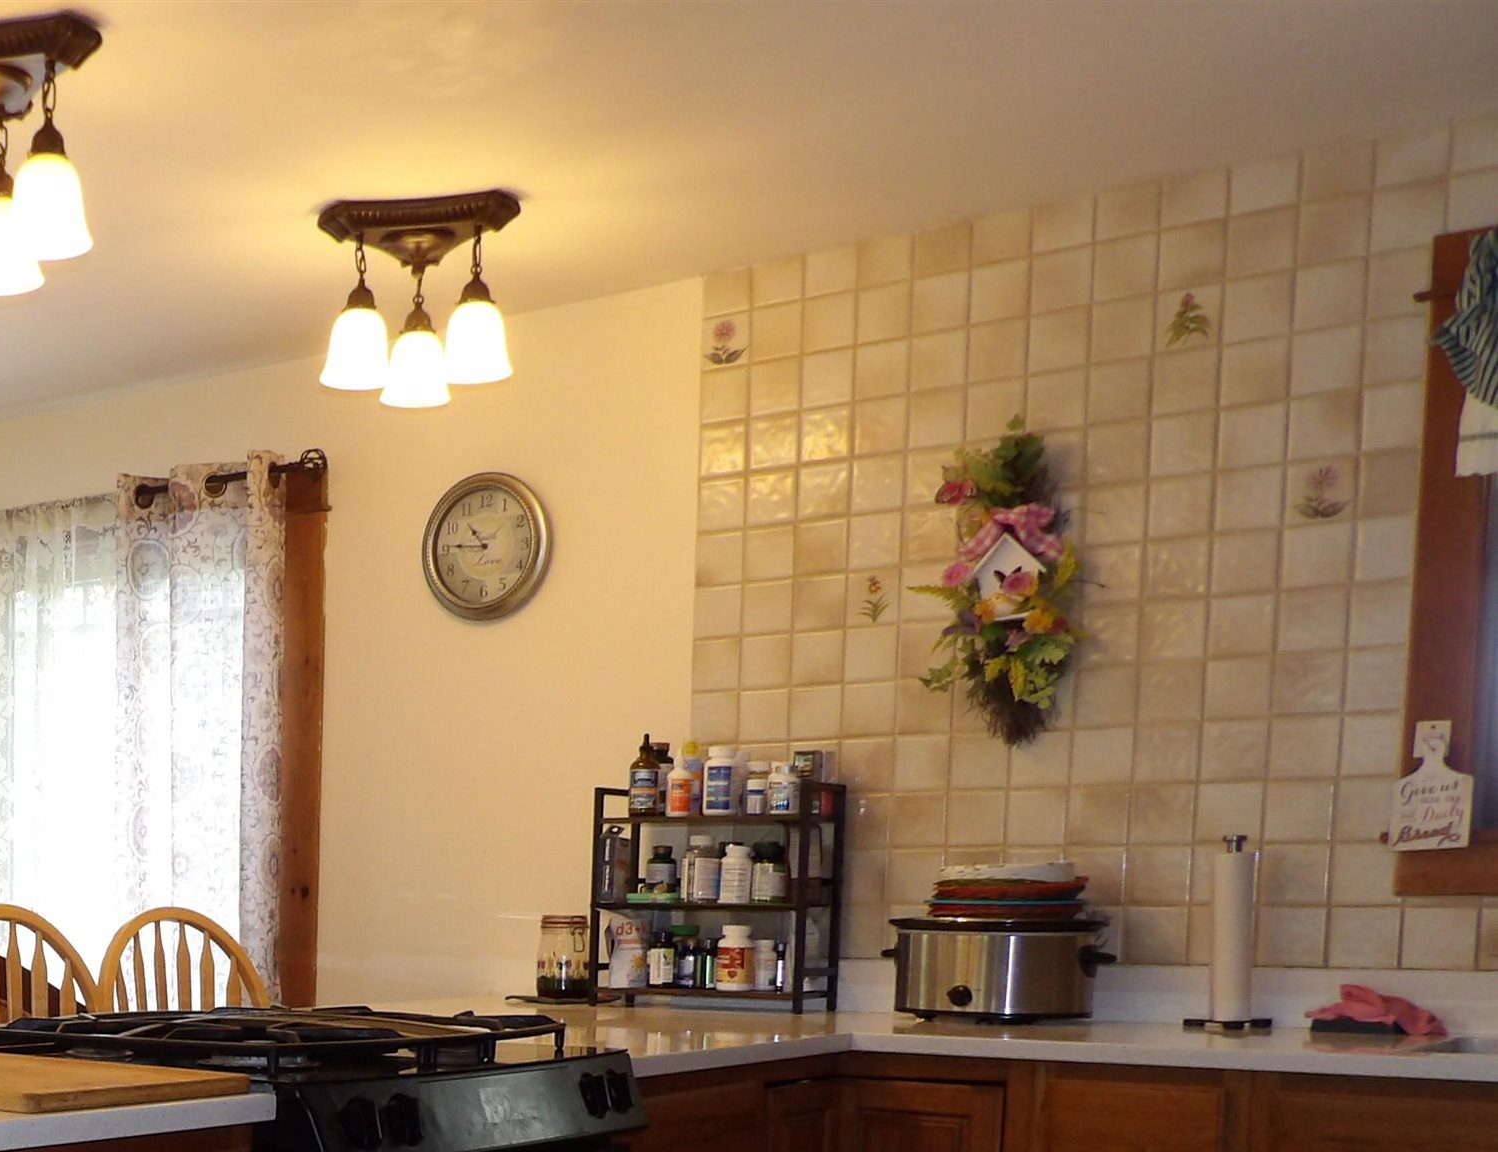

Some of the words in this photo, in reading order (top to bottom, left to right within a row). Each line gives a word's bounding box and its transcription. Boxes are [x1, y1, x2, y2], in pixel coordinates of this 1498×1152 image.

[481, 493, 493, 508] 12
[502, 498, 507, 511] 1
[462, 503, 471, 516] 11
[447, 521, 458, 535] 10
[516, 515, 525, 528] 2
[442, 543, 450, 556] 9
[521, 537, 529, 551] 3
[446, 564, 454, 576] 8
[515, 558, 523, 571] 4
[461, 580, 469, 593] 7
[498, 577, 507, 590] 5
[479, 586, 488, 599] 6
[1401, 781, 1436, 806] Give
[1393, 821, 1461, 846] Bread
